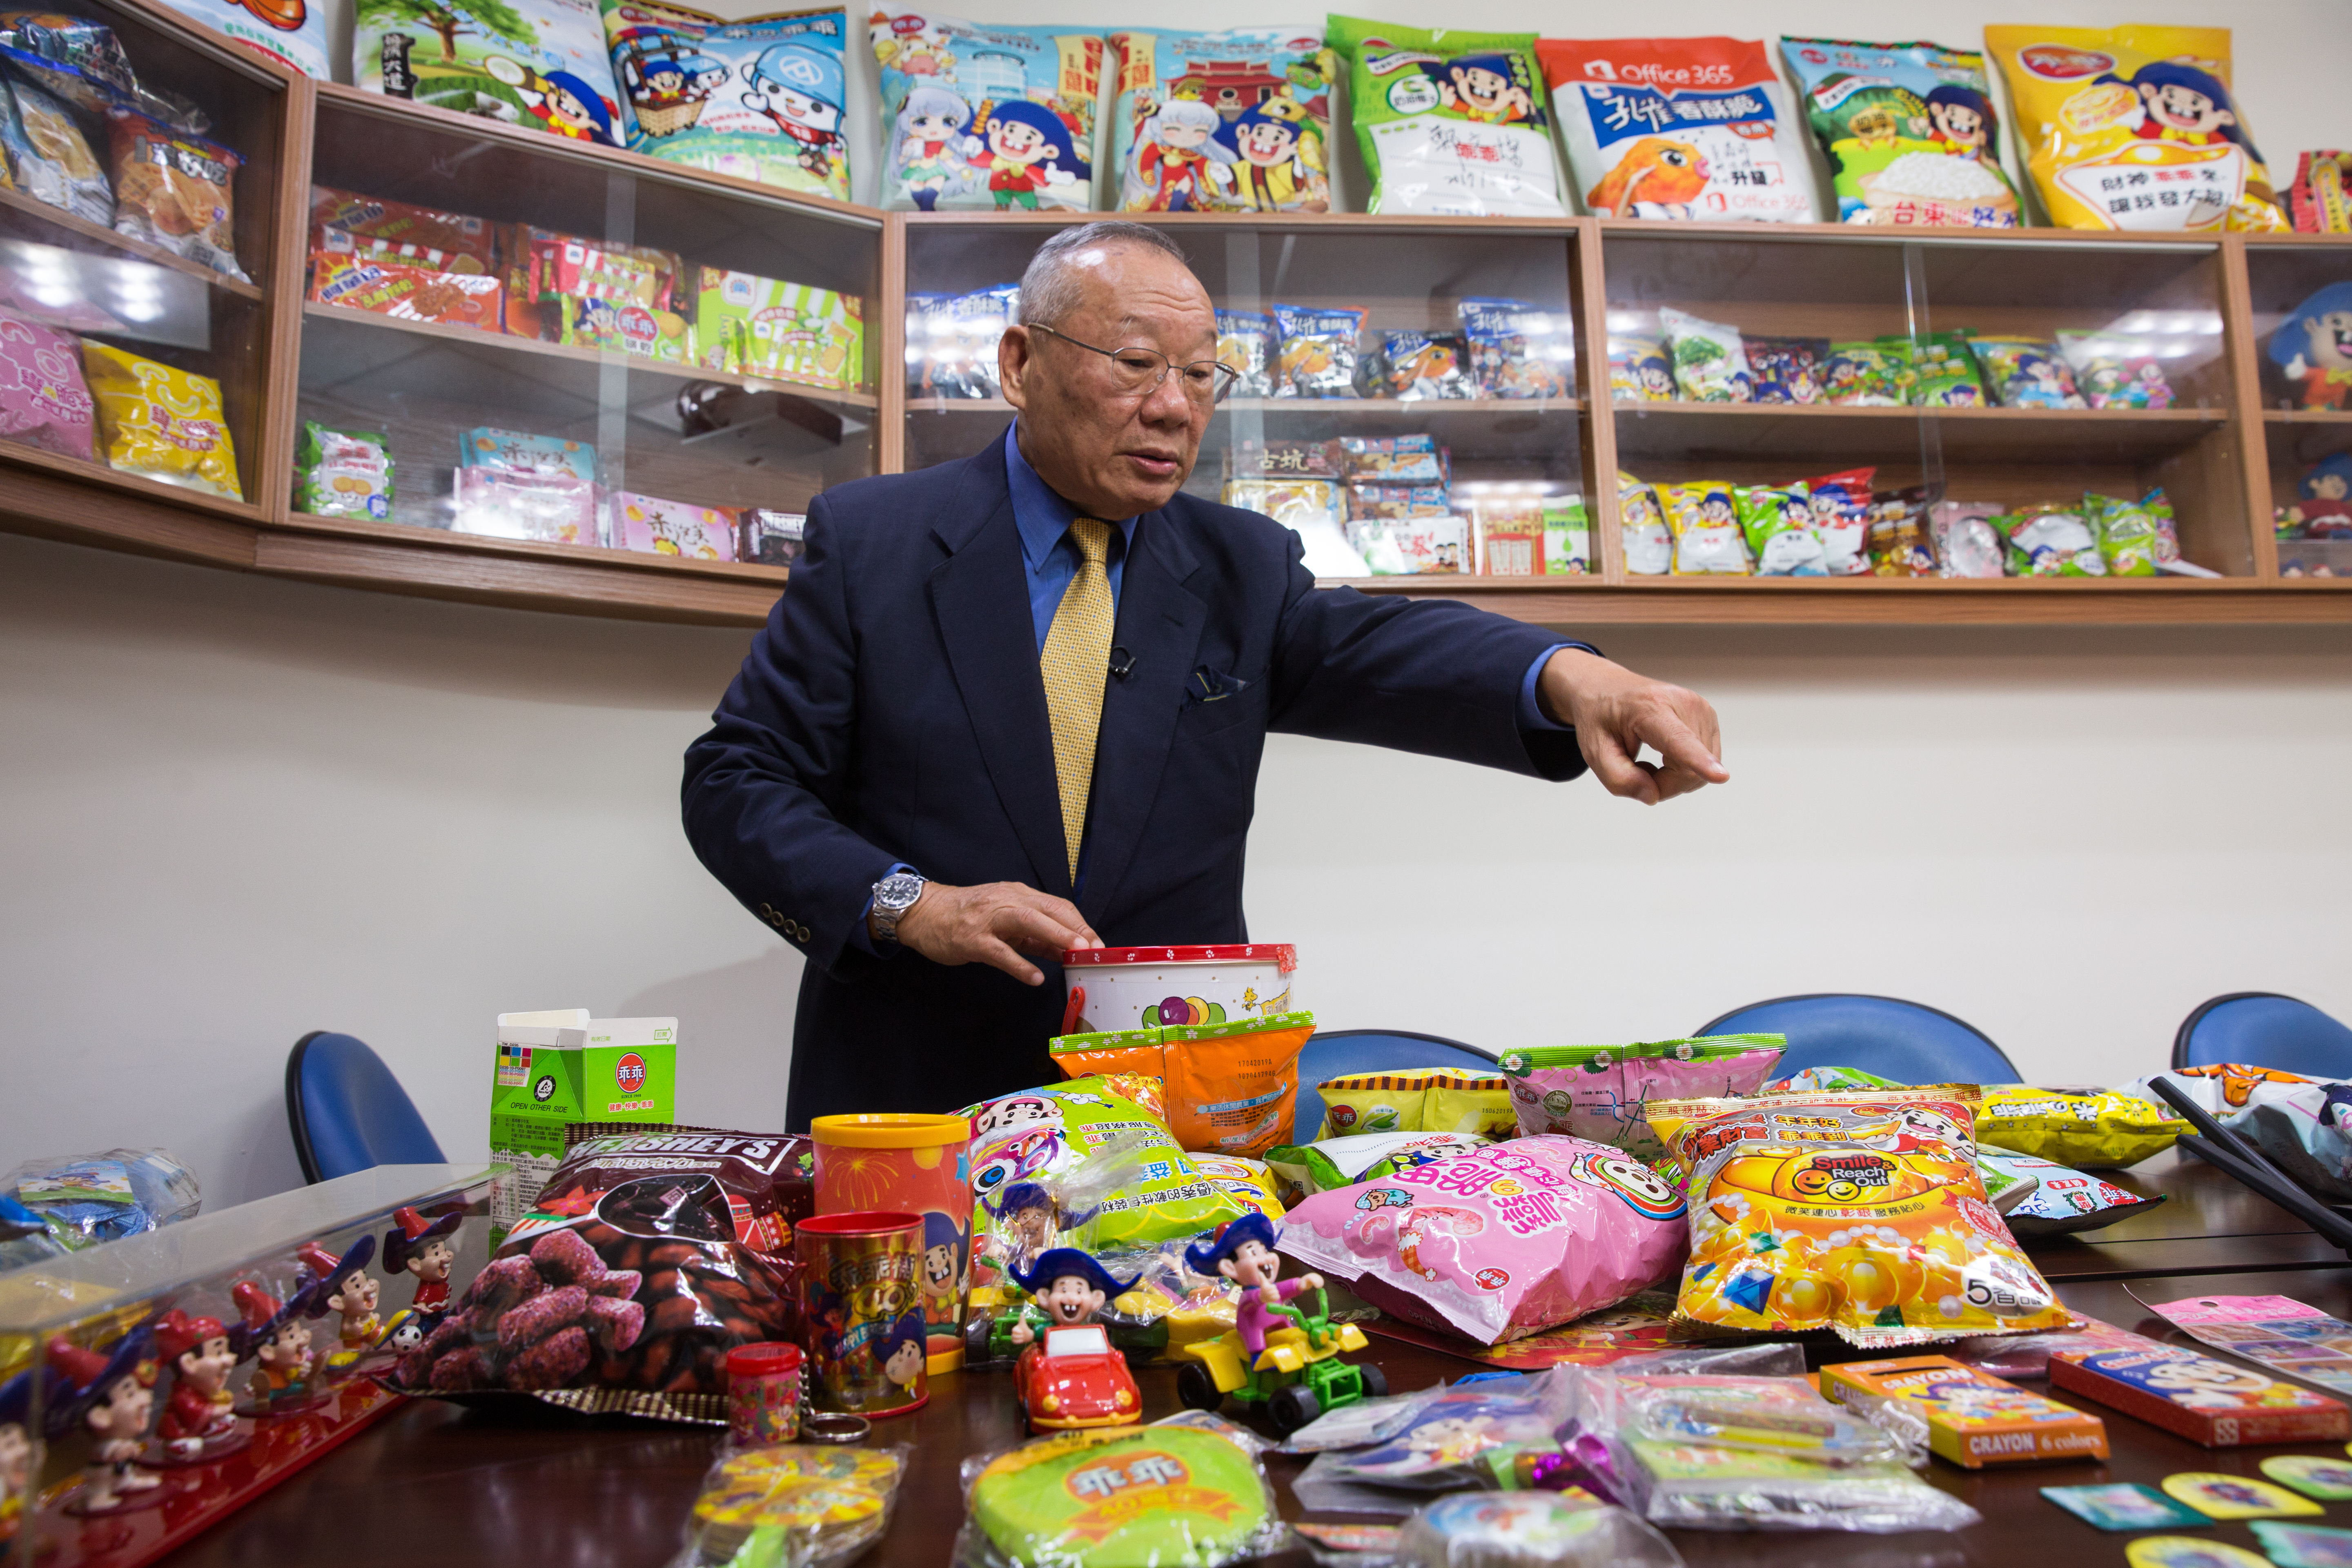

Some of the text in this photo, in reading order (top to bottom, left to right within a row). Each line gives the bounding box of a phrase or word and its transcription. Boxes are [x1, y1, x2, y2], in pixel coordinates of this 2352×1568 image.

[1621, 64, 1734, 84] Office 365
[1238, 1059, 1272, 1067] 17042019A
[618, 1065, 644, 1084] 乖乖
[1516, 1088, 1538, 1102] 乖乖
[1774, 1114, 1842, 1128] 年年好
[1778, 1130, 1848, 1143] 乖乖到
[569, 1136, 779, 1160] HERSHEY'S
[1815, 1155, 1894, 1170] Smile &
[1832, 1166, 1885, 1178] Reach
[1855, 1175, 1889, 1187] Out
[1840, 1207, 1873, 1218] 彰銀
[1479, 1270, 1506, 1287] 乖乖
[1882, 1368, 1974, 1390] CRAYON
[1969, 1432, 2102, 1456] CRAYON 6 colors
[1071, 1455, 1184, 1497] 乖乖
